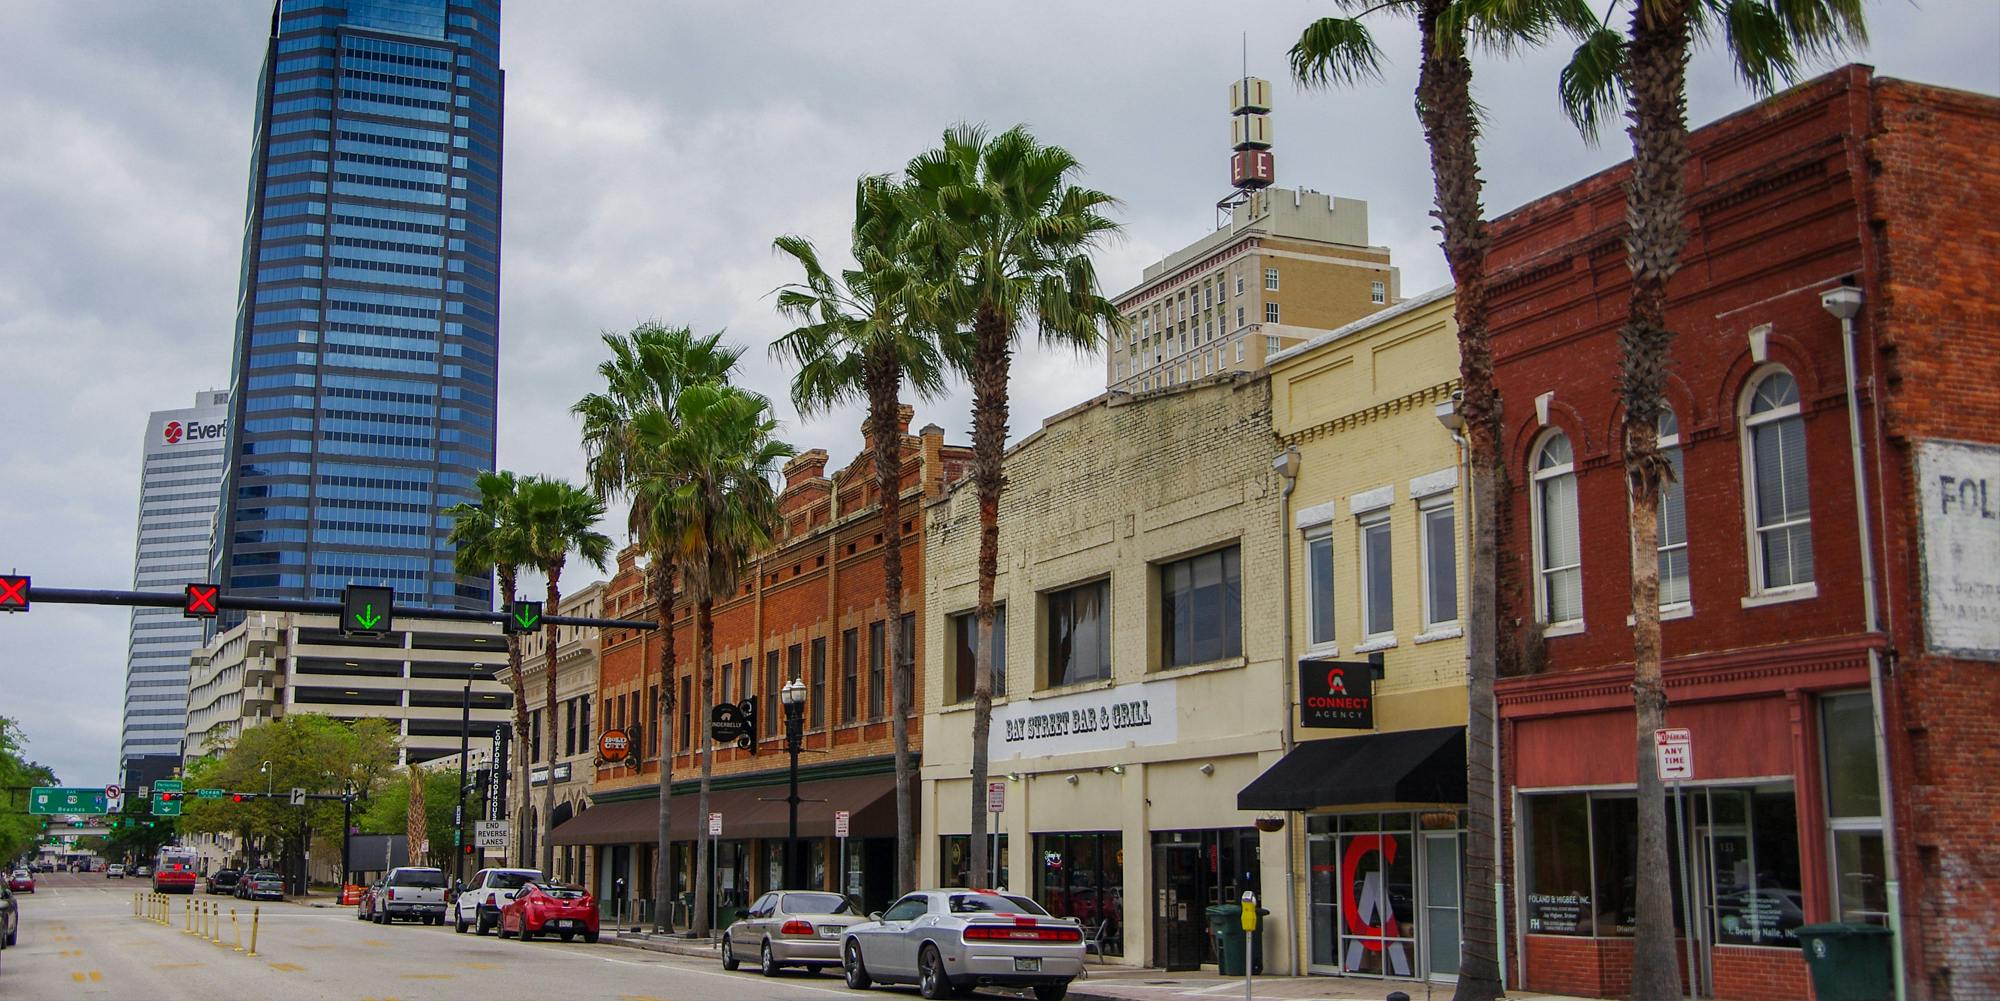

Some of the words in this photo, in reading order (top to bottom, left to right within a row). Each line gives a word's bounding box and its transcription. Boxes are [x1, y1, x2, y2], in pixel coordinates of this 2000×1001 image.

[186, 419, 227, 440] Ever
[1307, 696, 1369, 709] CONNECT
[1005, 717, 1025, 742] BAY
[1027, 711, 1070, 739] STREET
[1072, 707, 1098, 734] BAR
[1100, 706, 1110, 731] &
[1112, 700, 1152, 728] GRILL
[1315, 710, 1363, 719] AGENCY
[1656, 731, 1667, 744] NO
[493, 729, 502, 770] COWFORD
[1664, 747, 1683, 755] ANY
[491, 772, 499, 821] CHOPHOUS
[478, 830, 507, 838] REVERSE
[1528, 894, 1550, 904] FOLAND
[1551, 895, 1556, 904] &
[1556, 895, 1579, 905] HIGBEE,
[1579, 895, 1591, 904] INC.
[1530, 918, 1540, 929] FH
